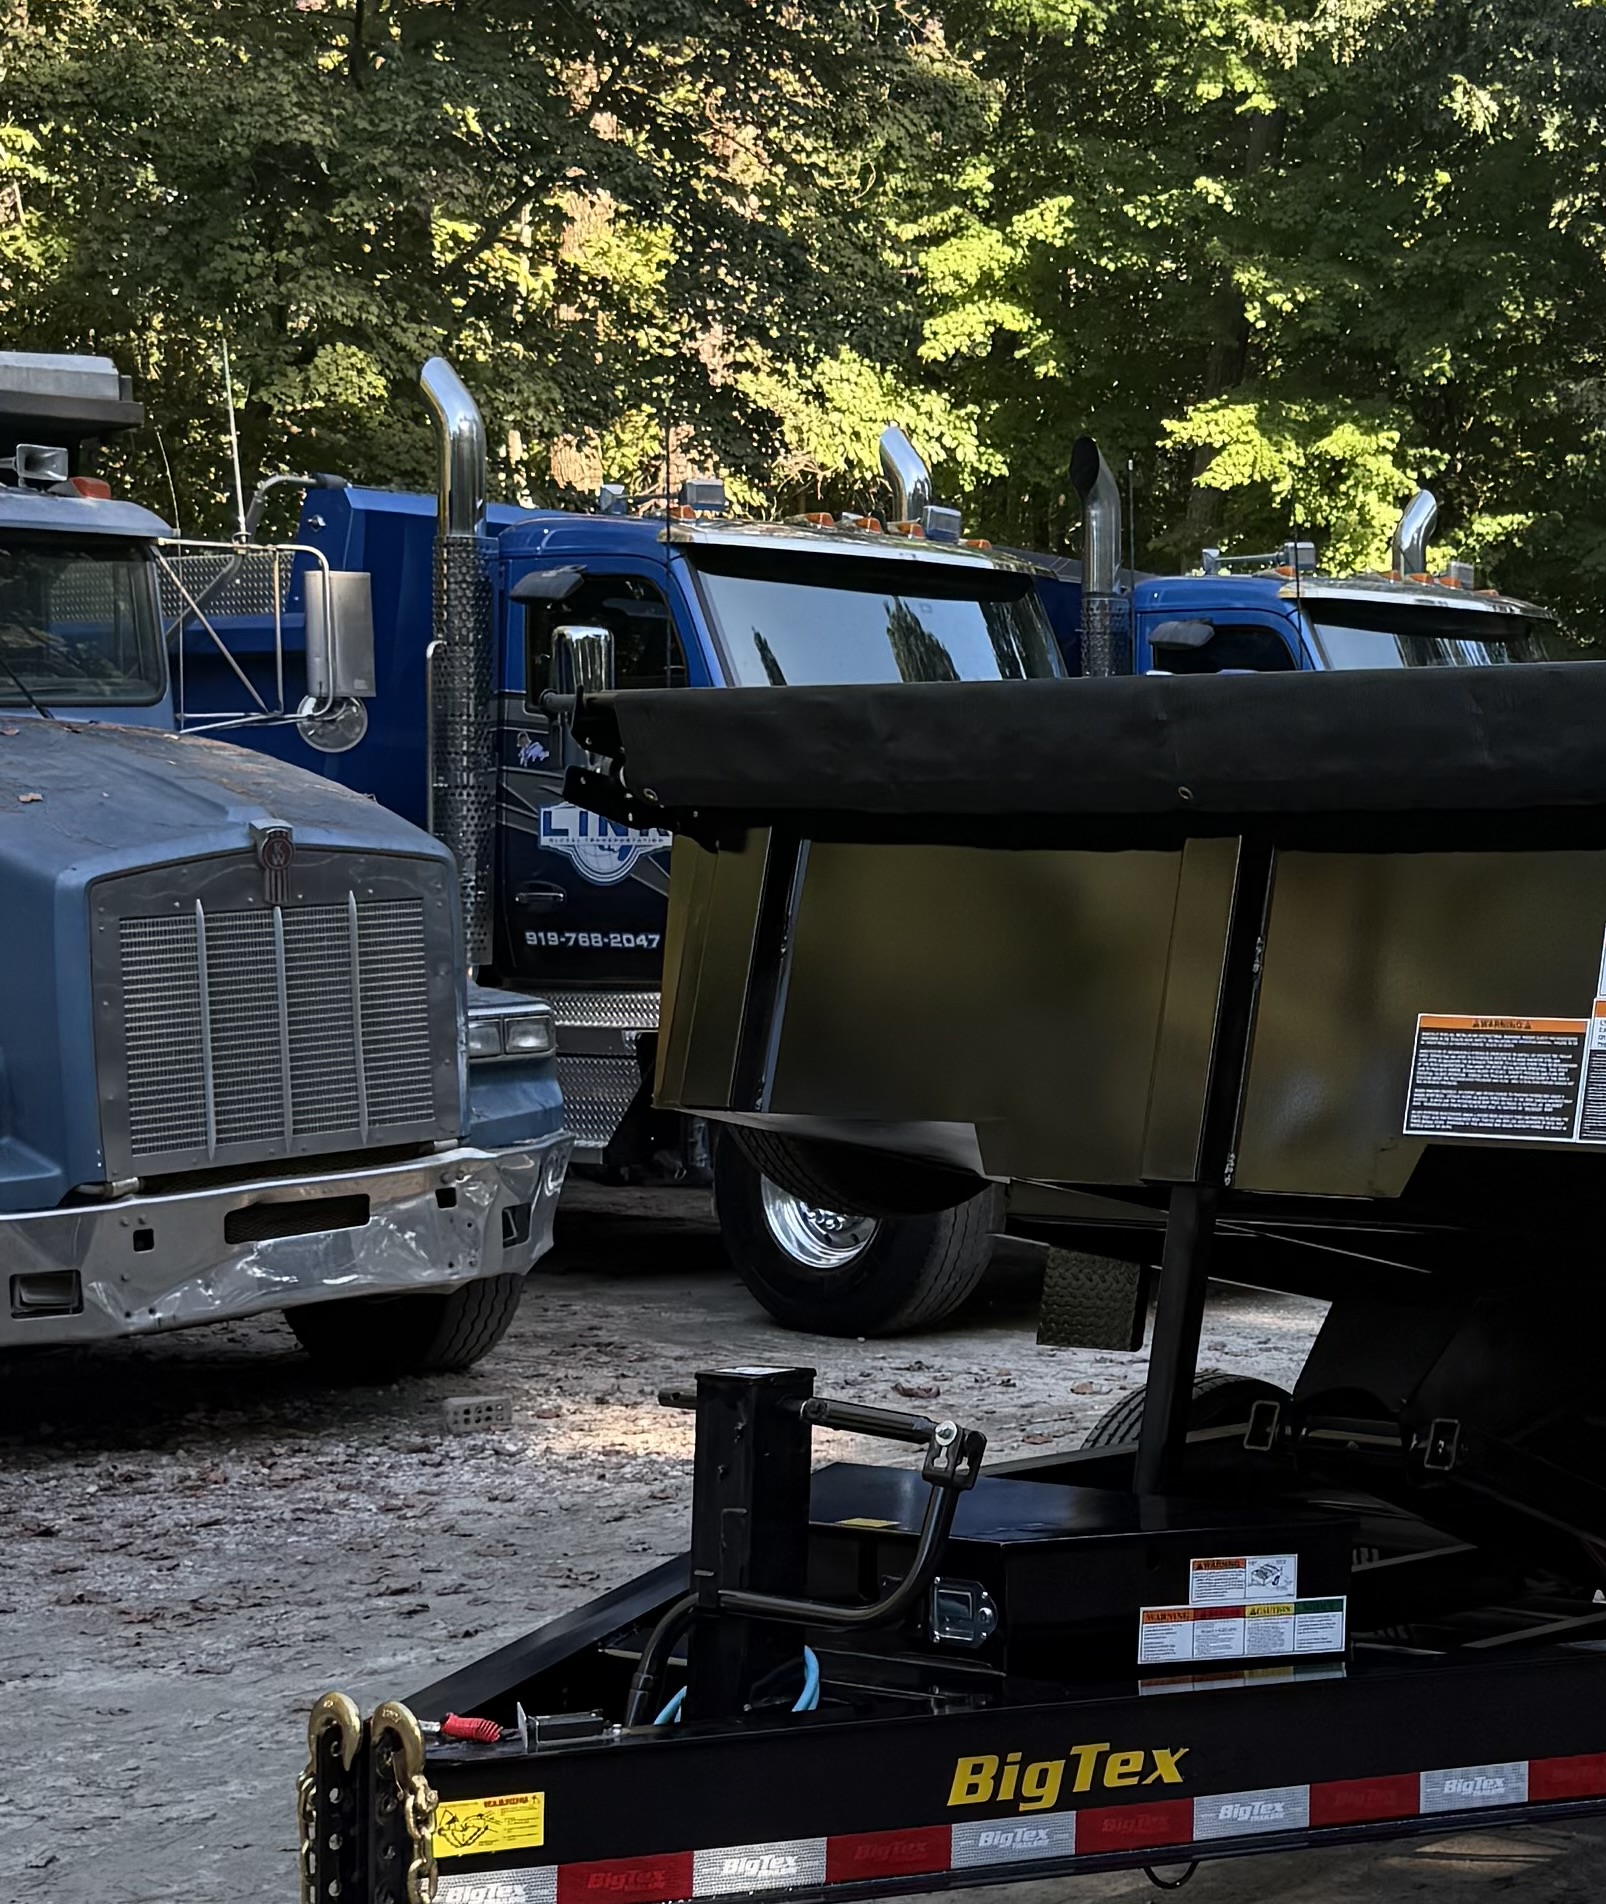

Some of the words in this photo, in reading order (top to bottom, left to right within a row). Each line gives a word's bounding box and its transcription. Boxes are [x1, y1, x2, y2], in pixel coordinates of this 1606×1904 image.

[525, 931, 661, 949] 919-768-2047
[946, 1742, 1190, 1812] BigTex
[1444, 1776, 1505, 1794] BigTex
[1219, 1801, 1285, 1820] BigTex
[978, 1827, 1050, 1848] BigTex
[723, 1854, 799, 1878] BigTex
